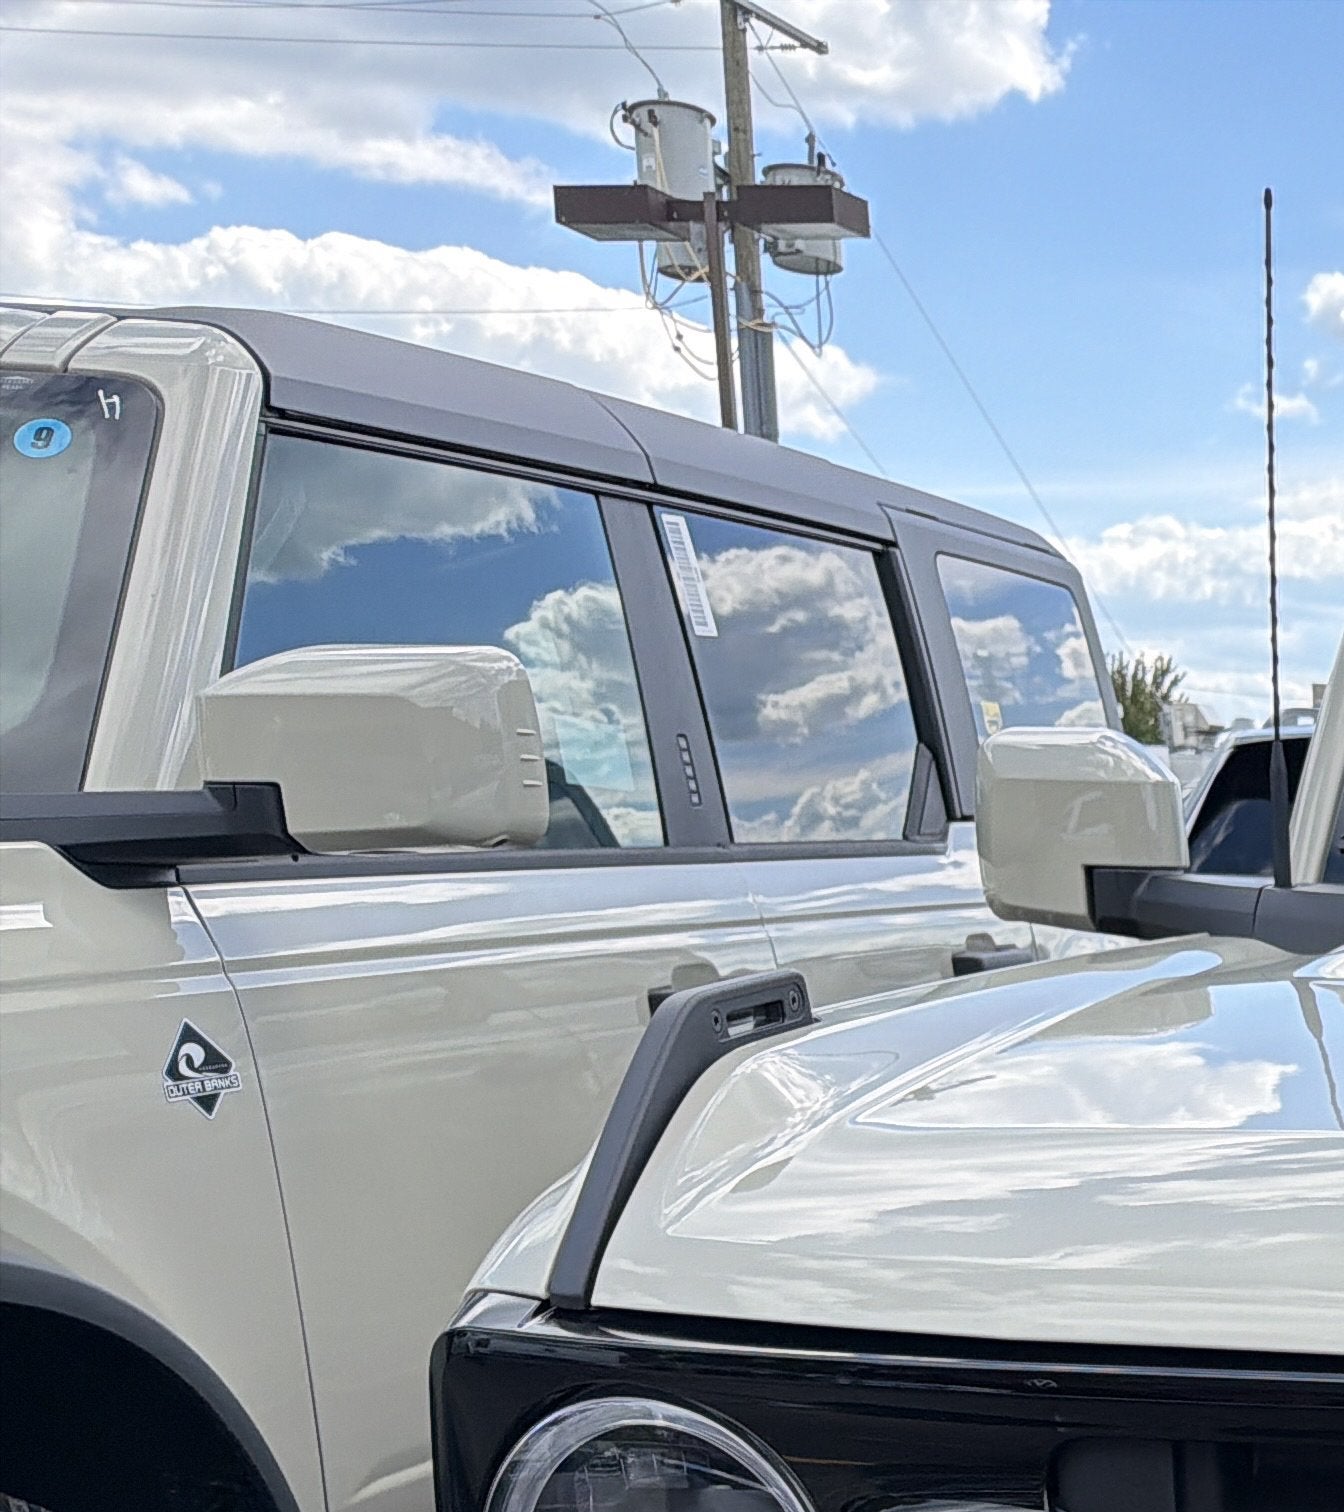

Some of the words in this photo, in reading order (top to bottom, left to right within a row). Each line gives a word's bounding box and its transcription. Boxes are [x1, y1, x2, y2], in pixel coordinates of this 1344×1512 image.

[30, 427, 55, 449] 9
[167, 1081, 202, 1098] OUTER
[204, 1074, 239, 1093] BANKS
